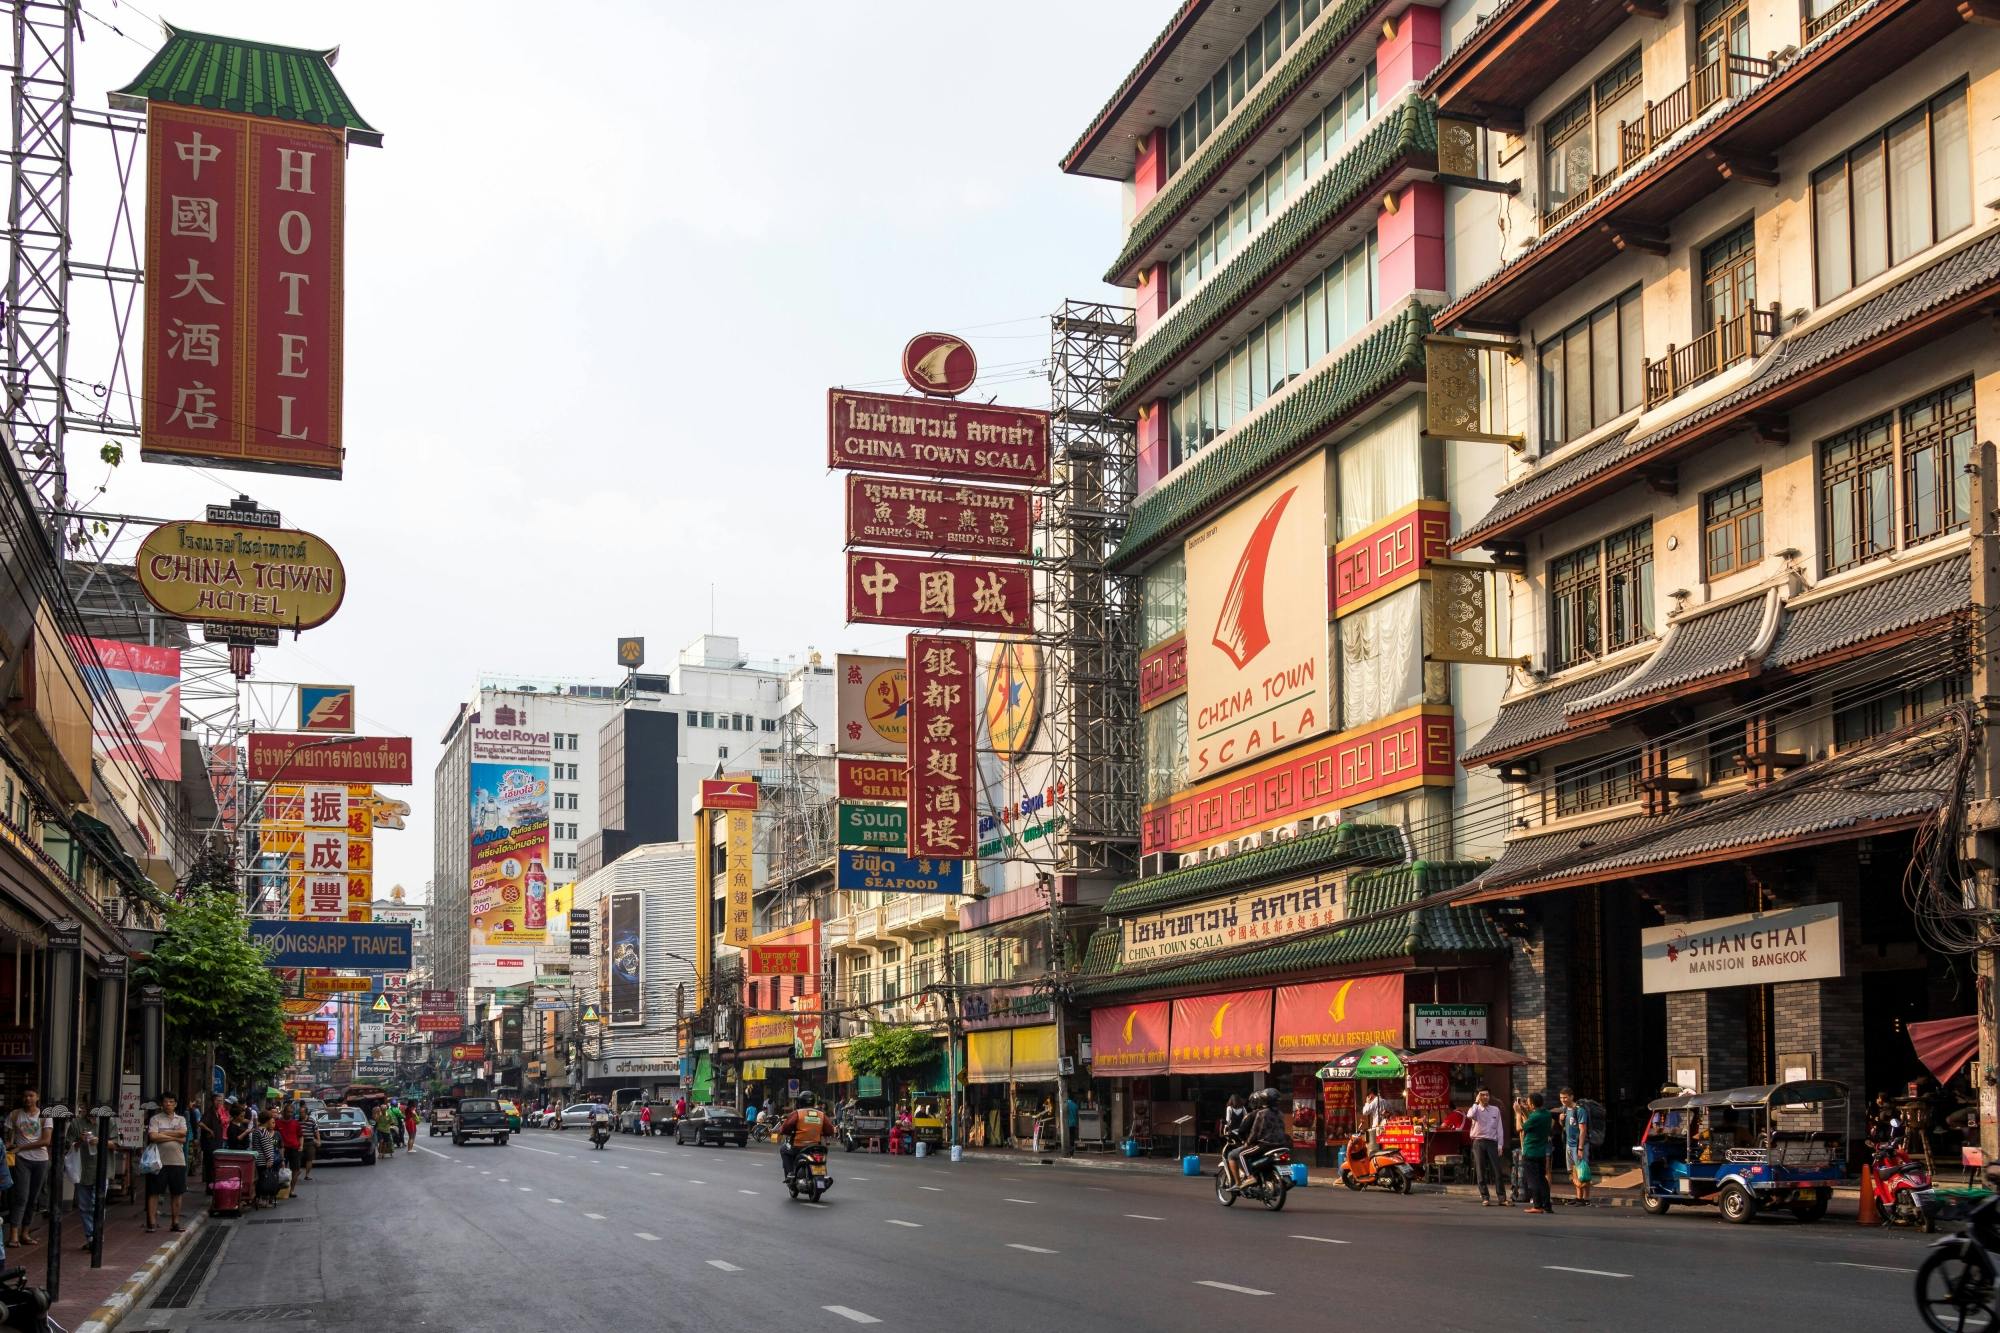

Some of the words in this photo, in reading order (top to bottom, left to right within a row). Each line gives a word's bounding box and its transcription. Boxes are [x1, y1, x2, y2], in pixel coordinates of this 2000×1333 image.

[165, 131, 226, 431] 中國大酒店
[276, 147, 316, 441] HOTEL
[846, 399, 957, 440] ไชน่าทาวน์
[967, 418, 1035, 447] สกาล่า
[844, 437, 906, 459] CHINA
[911, 443, 970, 465] TOWN
[974, 451, 1037, 472] SCALA
[872, 502, 929, 530] 魚翅
[863, 525, 912, 538] SHARK'S
[915, 531, 934, 540] FIN
[947, 532, 984, 544] BIRD'S
[987, 536, 1016, 547] NEST
[150, 553, 244, 588] CHINA
[252, 561, 333, 595] TOWN
[197, 589, 287, 616] HOTEL
[860, 560, 1014, 625] 中國城
[1197, 686, 1254, 731] CHINA
[1263, 656, 1316, 699] TOWN
[475, 727, 512, 741] Hotel
[513, 729, 550, 745] Royal
[878, 725, 901, 733] NAM
[1198, 706, 1316, 774] SCALA
[920, 647, 965, 850] 銀都魚翅酒樓
[850, 807, 902, 827] รังนก
[863, 831, 899, 842] BIRD
[310, 791, 342, 913] 振成豐
[864, 877, 938, 890] SEAFOOD
[1131, 895, 1239, 945] ไชน่าทาวน์
[1251, 874, 1337, 923] สกาล่า
[351, 935, 408, 955] TRAVEL
[1128, 944, 1156, 961] CHINA
[1158, 940, 1188, 956] TOWN
[1189, 933, 1224, 951] SCALA
[1689, 925, 1807, 957] SHANGHAI
[1688, 956, 1745, 974] MANSION
[1751, 950, 1808, 967] BANGKOK
[1279, 1035, 1299, 1048] CHINA
[1301, 1034, 1321, 1047] TOWN
[1322, 1032, 1345, 1046] SCALA
[1347, 1029, 1396, 1045] RESTAURANT
